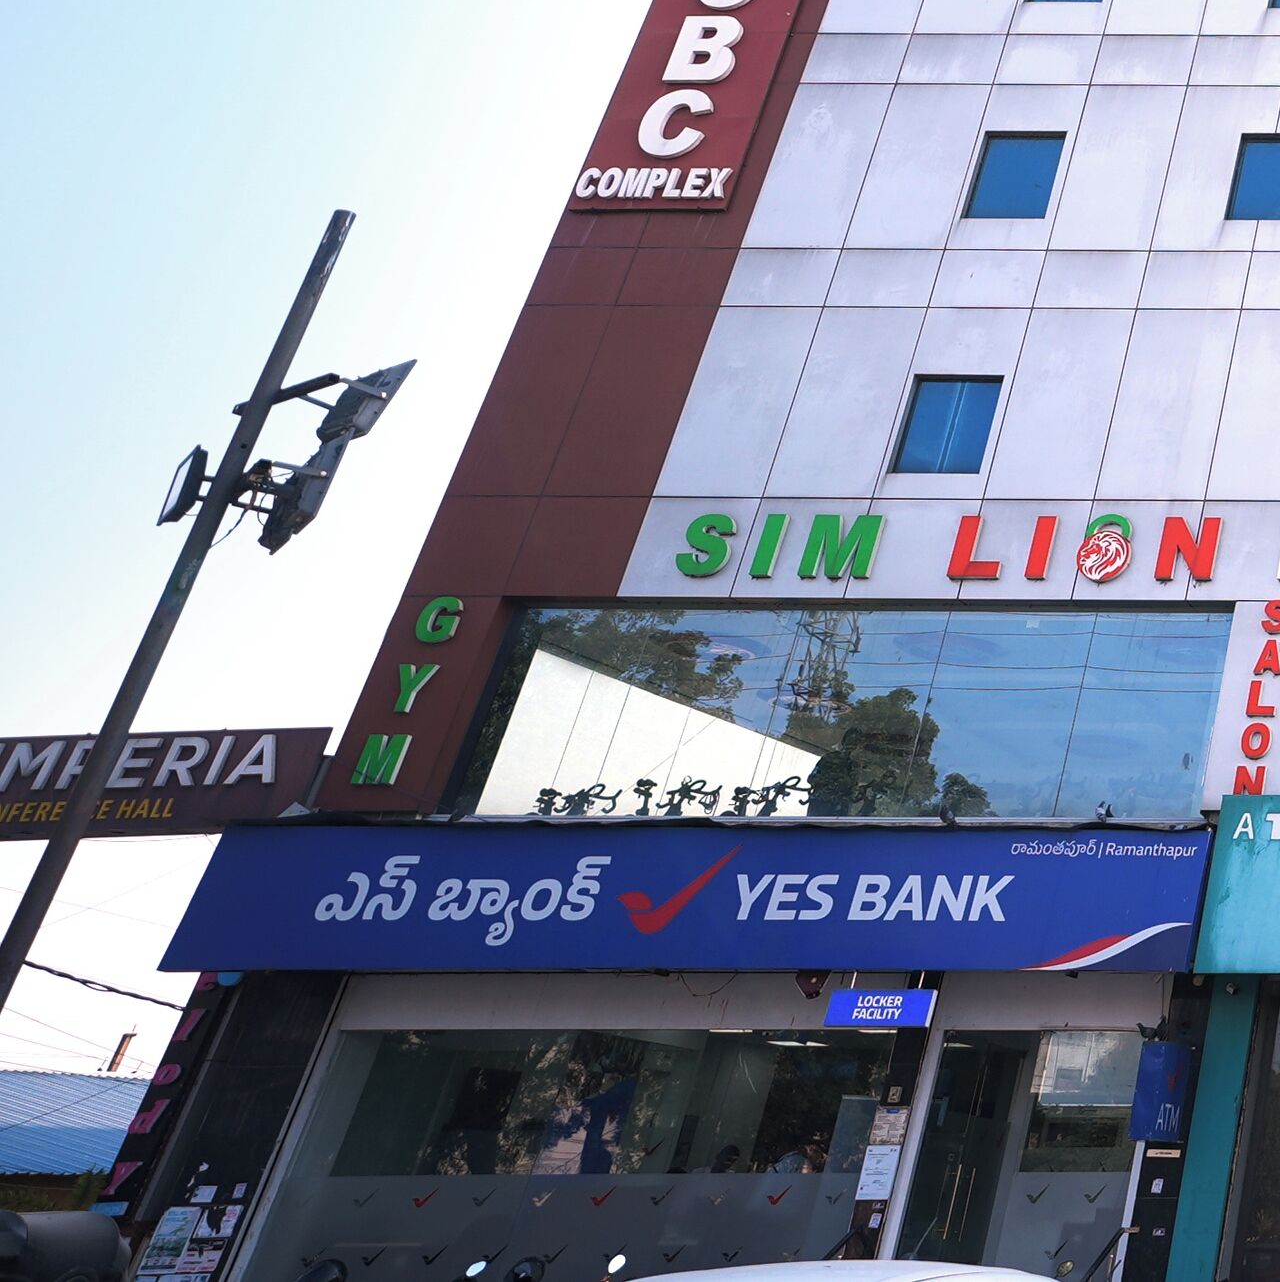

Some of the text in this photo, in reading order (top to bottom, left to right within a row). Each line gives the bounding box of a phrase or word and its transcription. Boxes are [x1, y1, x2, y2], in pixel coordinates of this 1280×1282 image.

[575, 167, 733, 199] COMPLEX
[676, 512, 886, 580] SIM
[351, 596, 464, 785] GYM
[115, 797, 175, 820] HALL
[1232, 812, 1255, 840] A
[1105, 842, 1198, 861] Ramanthapur
[736, 873, 1016, 921] YES BANK
[852, 1008, 902, 1020] FACILITY
[857, 995, 903, 1007] LOCKER
[1155, 1102, 1181, 1133] ATM
